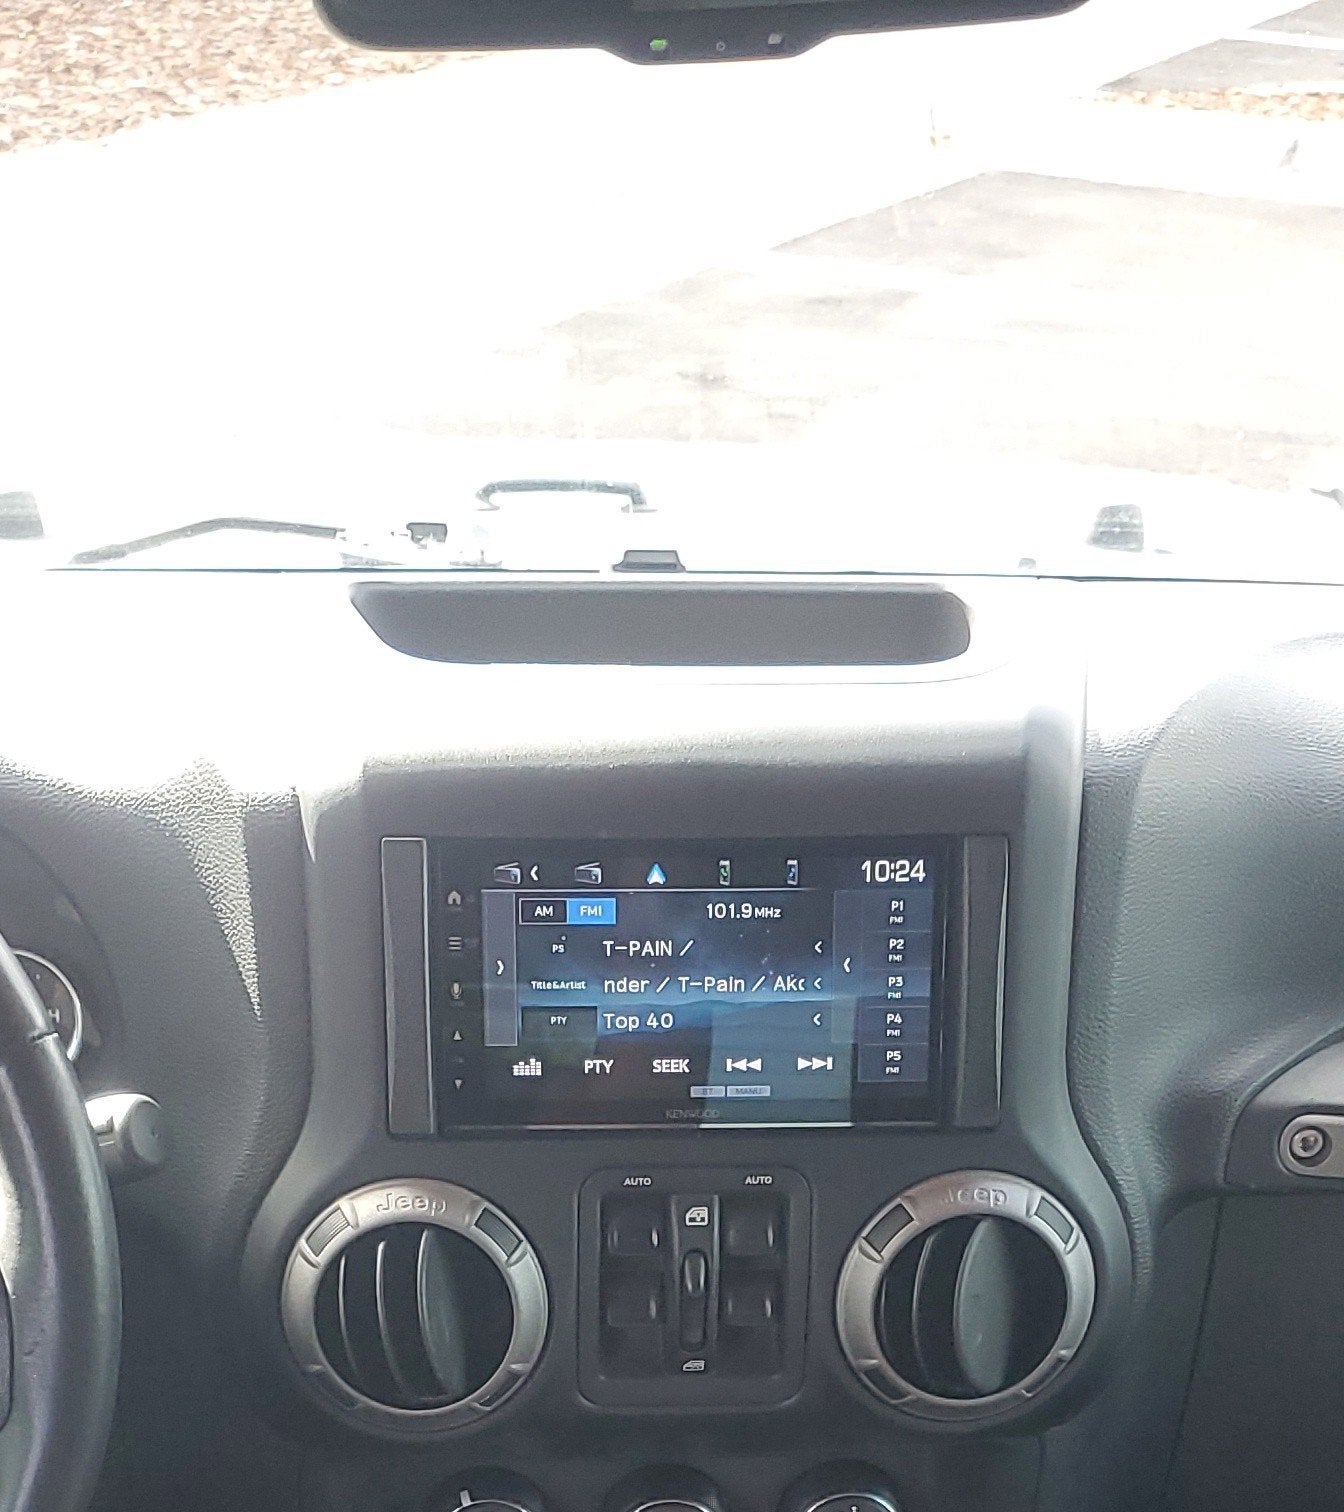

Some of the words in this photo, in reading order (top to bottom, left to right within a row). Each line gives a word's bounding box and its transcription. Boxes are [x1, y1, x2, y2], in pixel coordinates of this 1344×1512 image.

[861, 859, 926, 883] 10:24
[534, 905, 554, 917] AM
[891, 900, 904, 911] P1
[552, 944, 565, 953] PS
[602, 940, 673, 957] T-PAIN
[889, 938, 904, 950] P2
[604, 976, 650, 993] nder
[678, 976, 745, 993] T-Pain
[888, 976, 903, 987] P3
[550, 1015, 568, 1026] PTY
[603, 1013, 640, 1031] Top
[646, 1013, 674, 1029] 40
[887, 1013, 902, 1025] P4
[886, 1050, 902, 1061] P5
[584, 1059, 614, 1074] PTY
[652, 1058, 691, 1074] SEEK
[623, 1177, 652, 1186] AUTO
[744, 1175, 773, 1185] AUTO
[376, 1192, 448, 1217] Jeep
